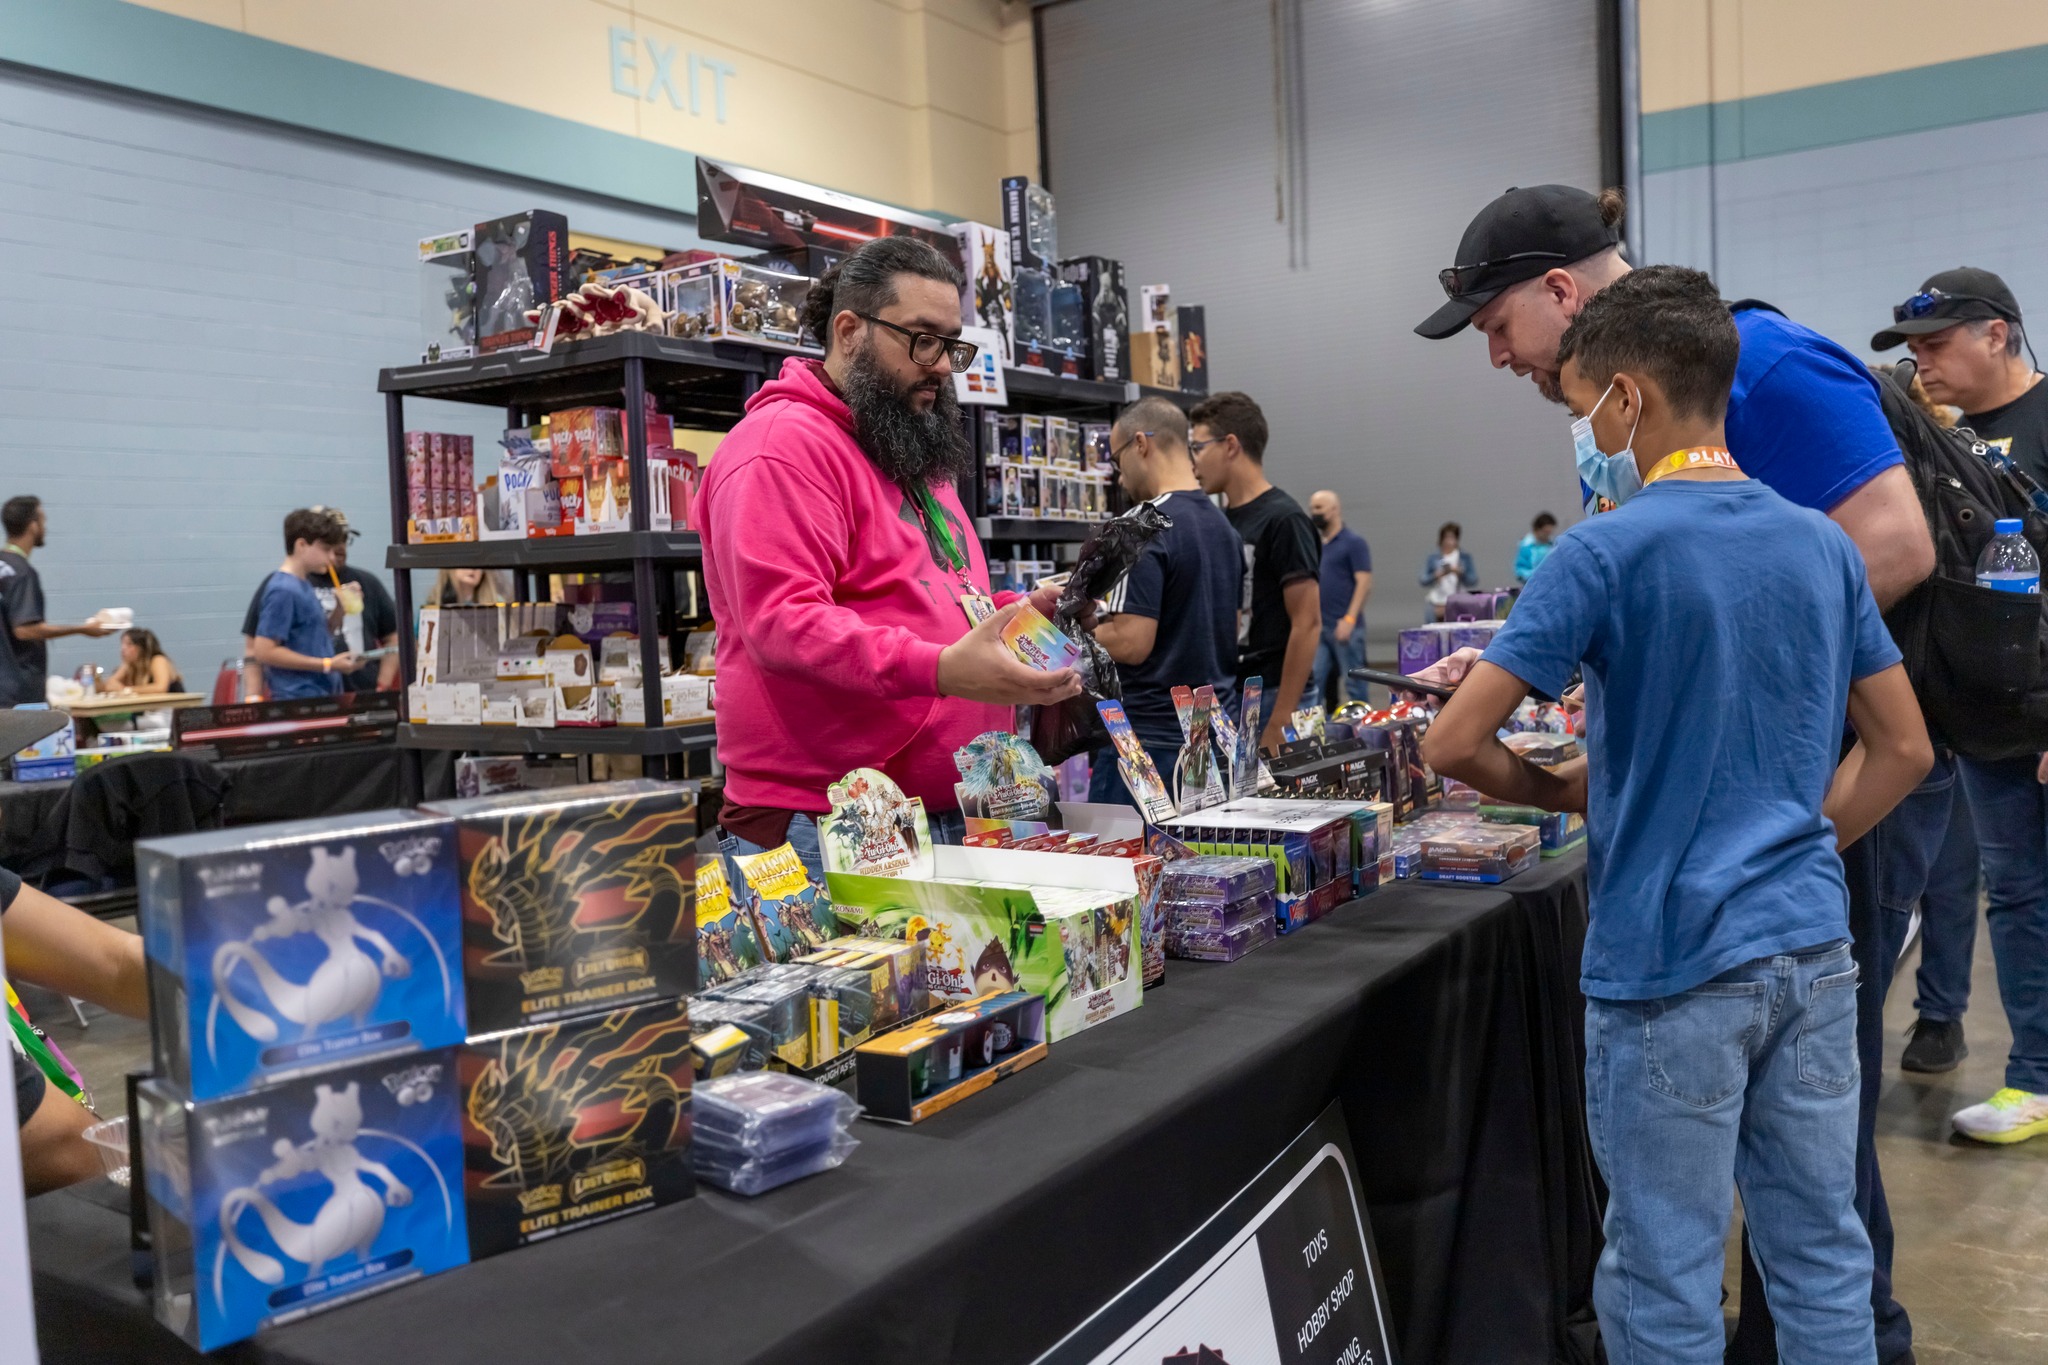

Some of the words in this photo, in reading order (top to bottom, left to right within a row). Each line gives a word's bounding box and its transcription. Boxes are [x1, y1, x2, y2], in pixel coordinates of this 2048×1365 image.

[609, 25, 737, 124] EXIT
[1009, 190, 1020, 223] BATMAN
[548, 231, 557, 267] THINGS
[553, 431, 573, 446] POCKY
[574, 428, 595, 443] POCKY
[668, 463, 693, 483] OCKY
[560, 494, 582, 510] POCKY
[1349, 760, 1366, 769] MAGIC
[1301, 774, 1318, 784] MAGIC
[745, 849, 799, 880] DRAGON
[860, 863, 883, 876] HIDDEN
[884, 857, 910, 870] ARSENAL
[834, 905, 864, 915] KONAMI
[928, 971, 962, 988] Gi-Oh!
[521, 994, 560, 1013] ELITE
[563, 982, 625, 1004] TRAINER
[626, 976, 656, 992] BOX
[361, 1029, 382, 1042] Box
[814, 1068, 839, 1085] TOUGH
[840, 1062, 849, 1075] AS
[520, 1212, 559, 1233] ELITE
[561, 1194, 622, 1221] TRAINER
[624, 1185, 653, 1203] BOX
[1302, 1228, 1328, 1268] TOYS
[365, 1261, 386, 1276] Box
[1297, 1297, 1330, 1354] HOBBY
[1330, 1268, 1354, 1312] SHOP
